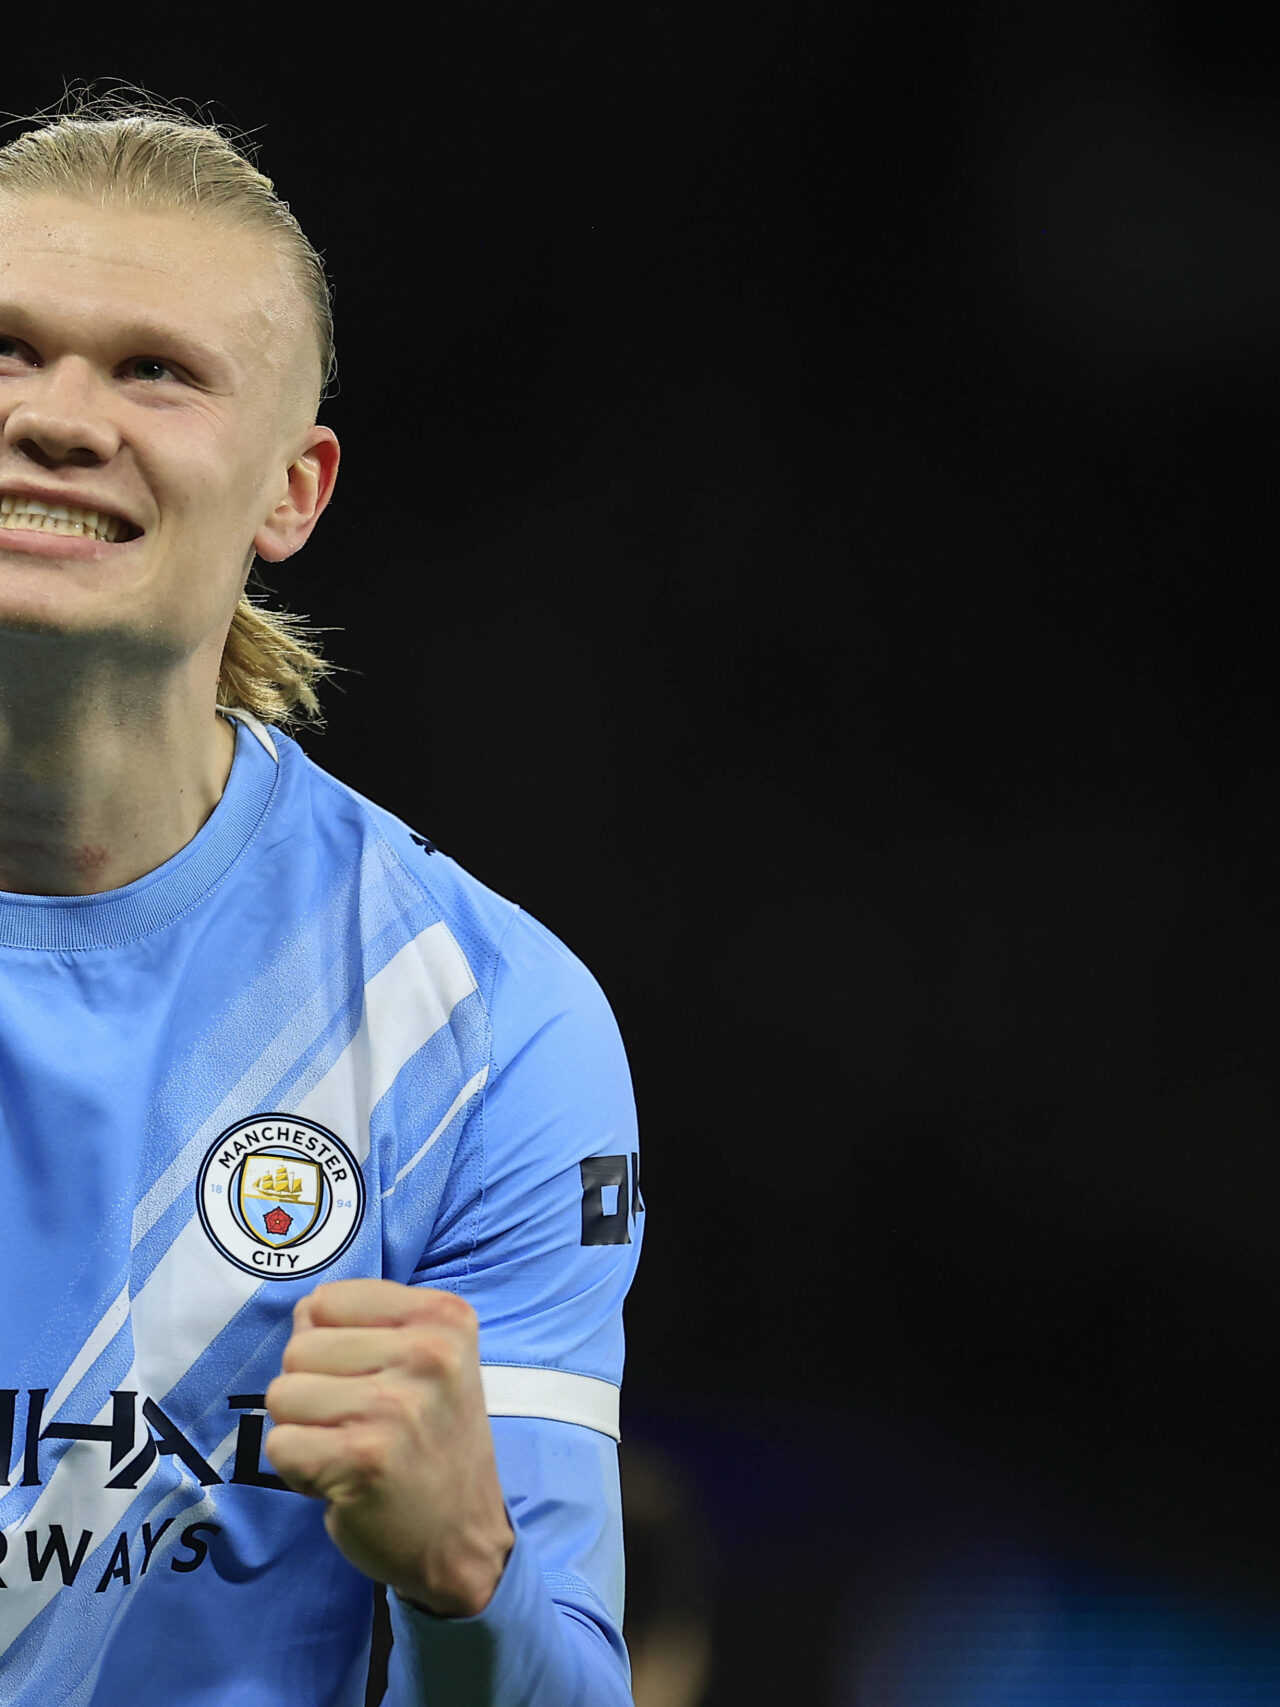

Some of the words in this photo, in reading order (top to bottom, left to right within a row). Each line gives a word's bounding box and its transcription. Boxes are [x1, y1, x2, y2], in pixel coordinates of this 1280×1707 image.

[218, 1126, 348, 1184] MANCHESTER
[209, 1183, 223, 1194] 18
[336, 1199, 353, 1209] 94
[251, 1250, 300, 1269] CITY
